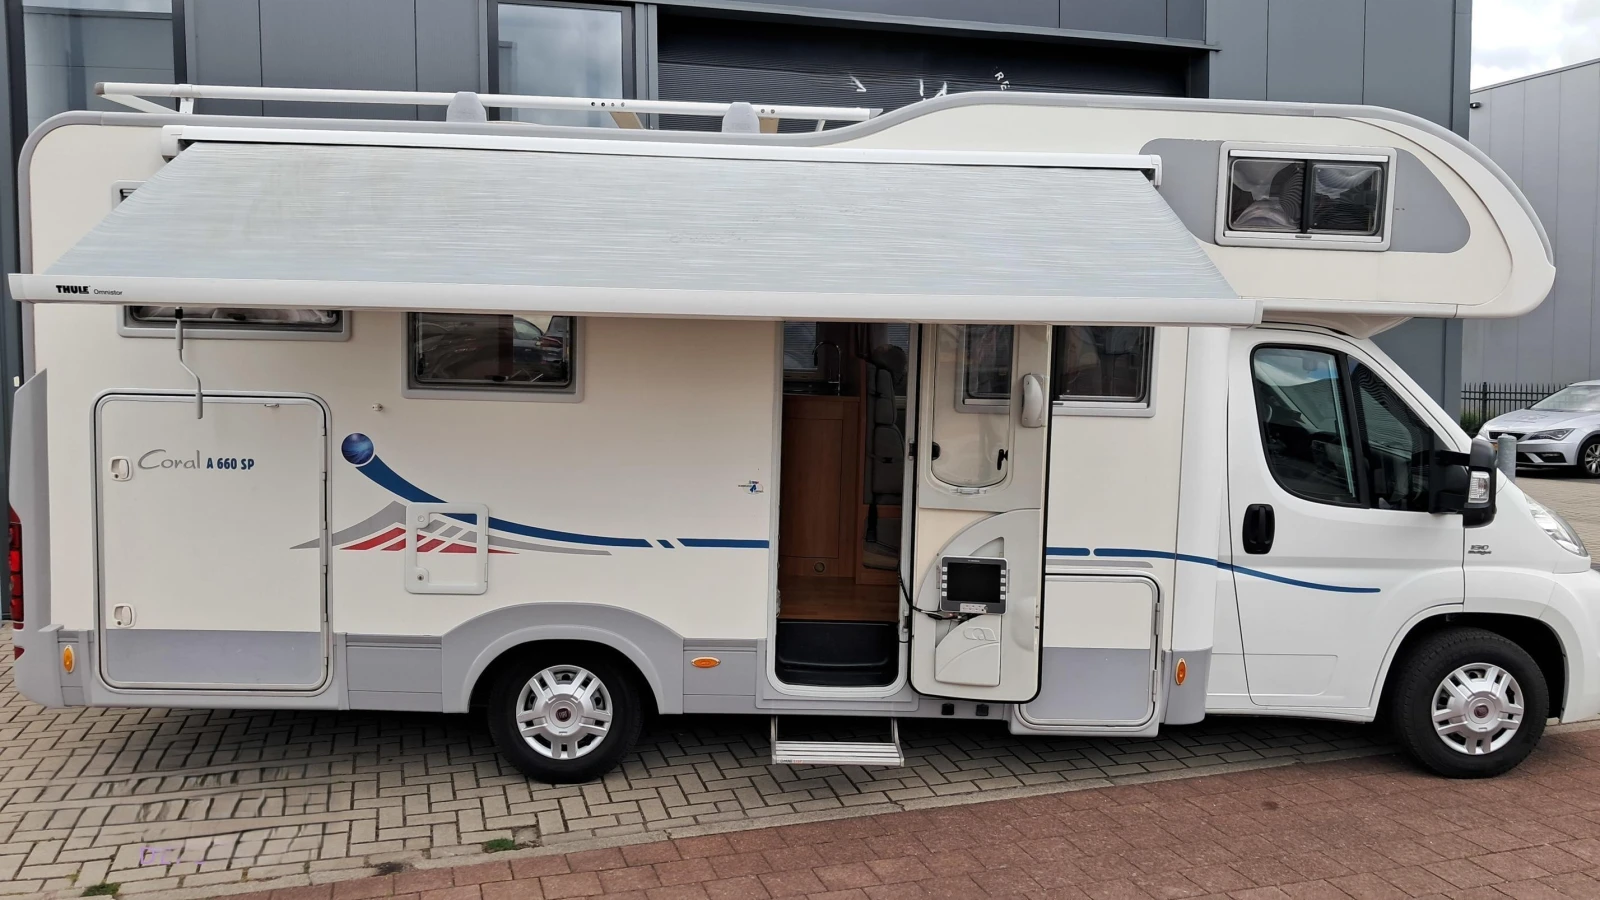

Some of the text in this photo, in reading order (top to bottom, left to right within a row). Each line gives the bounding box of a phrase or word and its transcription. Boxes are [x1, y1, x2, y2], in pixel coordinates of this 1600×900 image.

[56, 285, 90, 294] THULE
[138, 449, 255, 470] Coral A 660 SP
